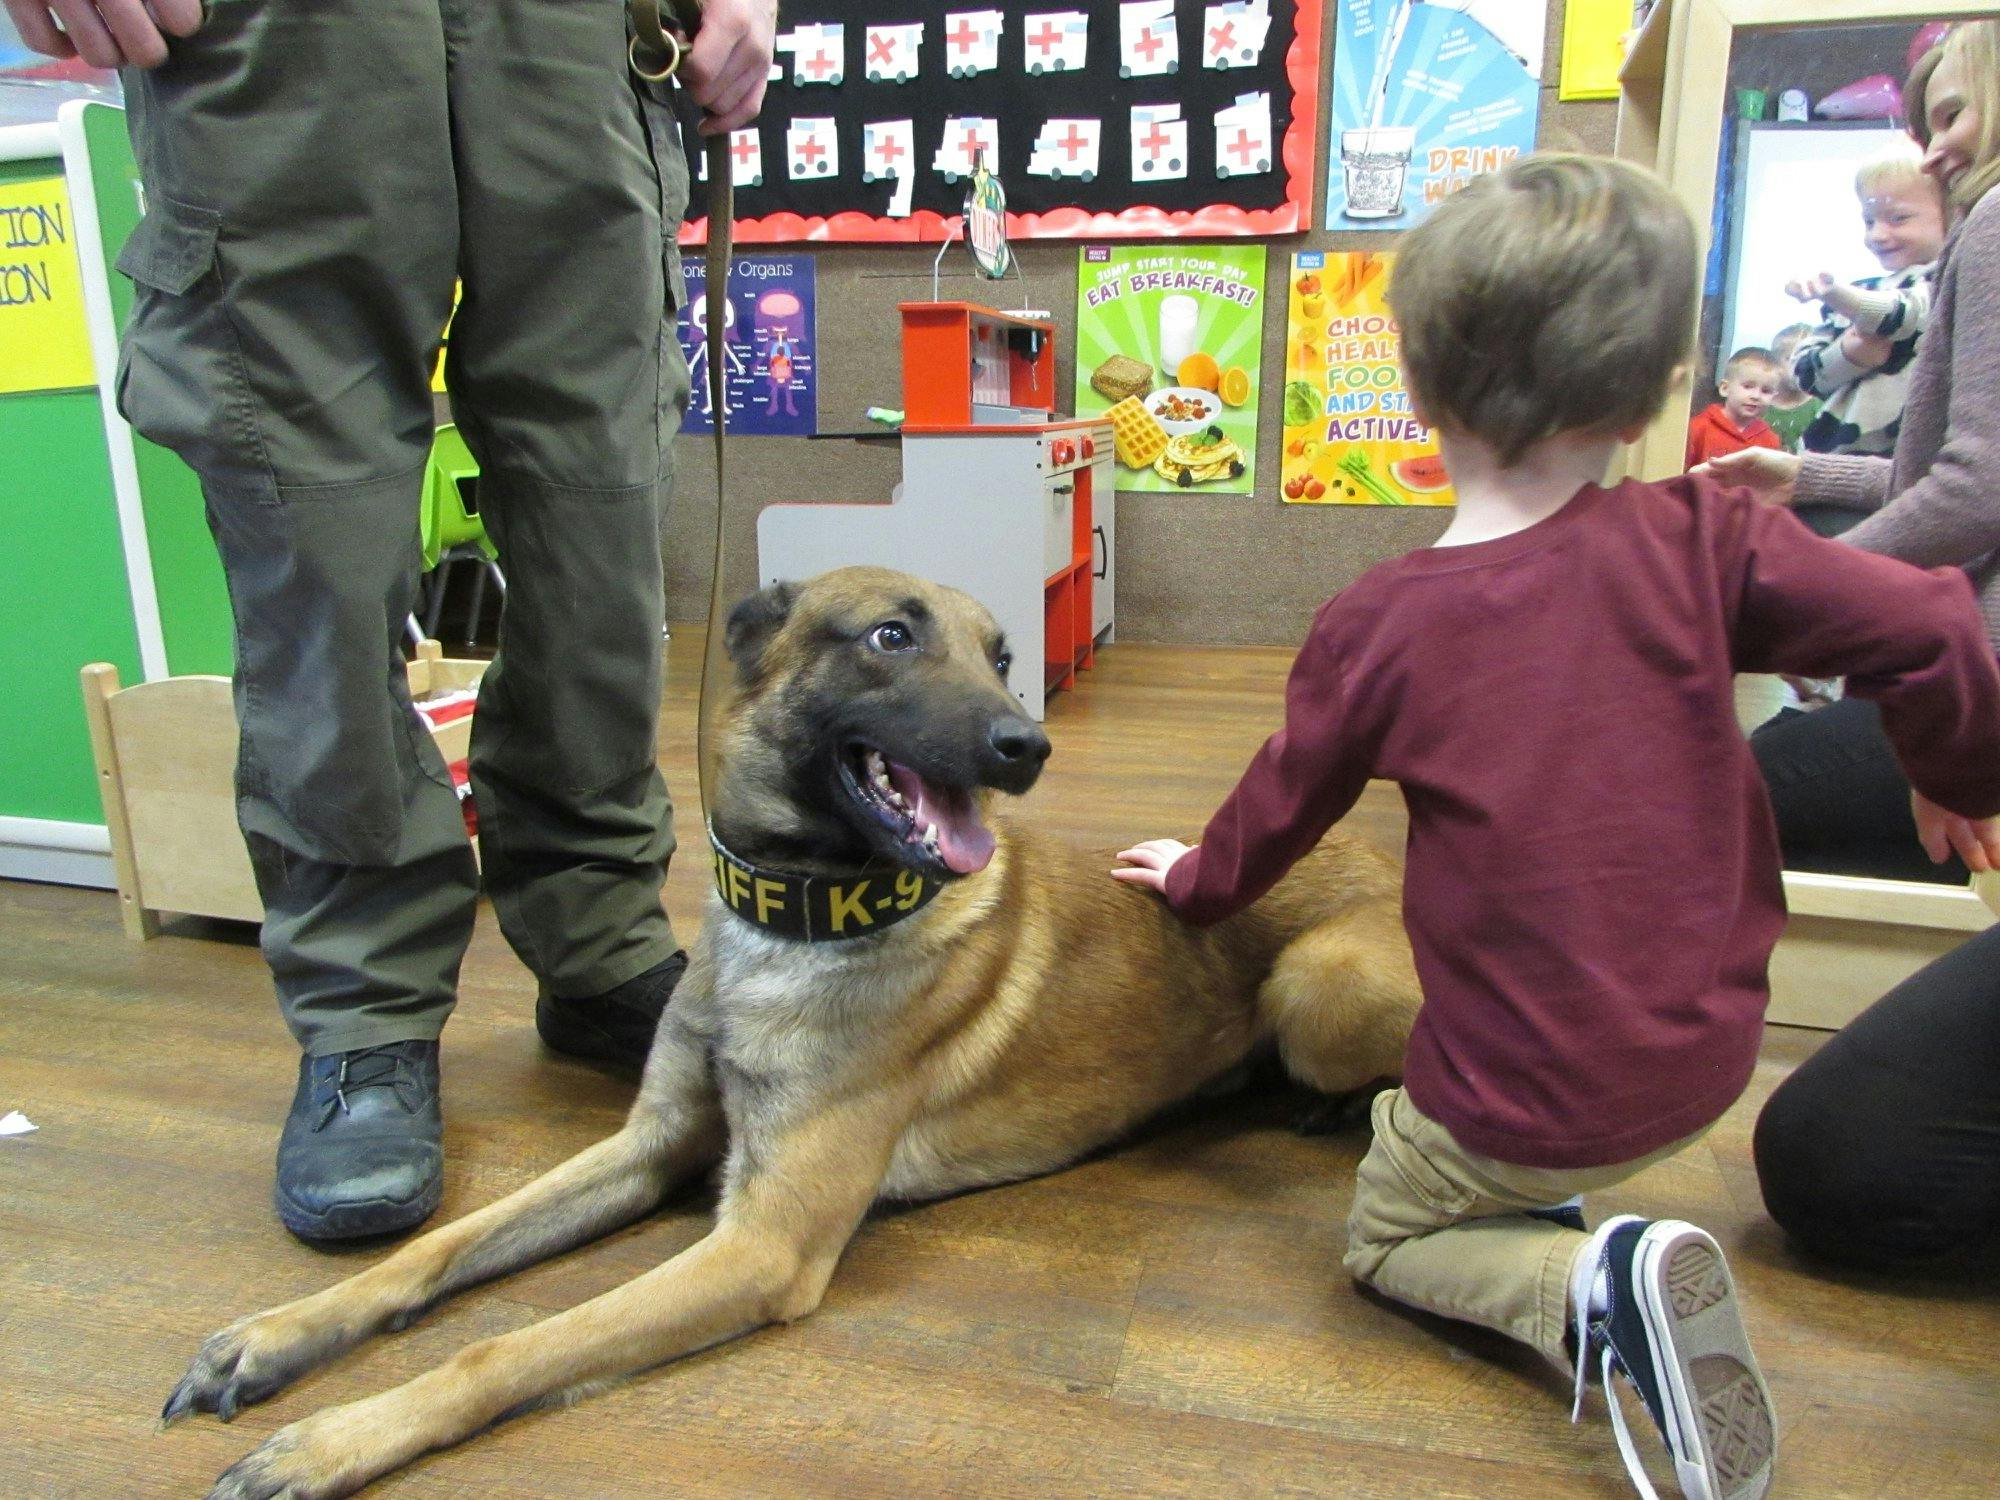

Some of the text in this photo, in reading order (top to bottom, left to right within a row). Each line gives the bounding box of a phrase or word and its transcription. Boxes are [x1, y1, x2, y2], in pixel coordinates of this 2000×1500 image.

[1428, 147, 1519, 174] DRINK
[0, 203, 65, 248] ION
[738, 261, 793, 280] Organs
[1097, 257, 1248, 281] JUMP START YOUR DAY
[1087, 271, 1256, 307] EAT BREAKFAST!
[1327, 317, 1401, 337] CHO
[1327, 341, 1400, 363] HEAL
[1327, 366, 1405, 389] FOO
[1327, 392, 1416, 414] AND ST
[1328, 417, 1429, 442] ACTIVE!
[714, 853, 924, 932] IFF K-9
